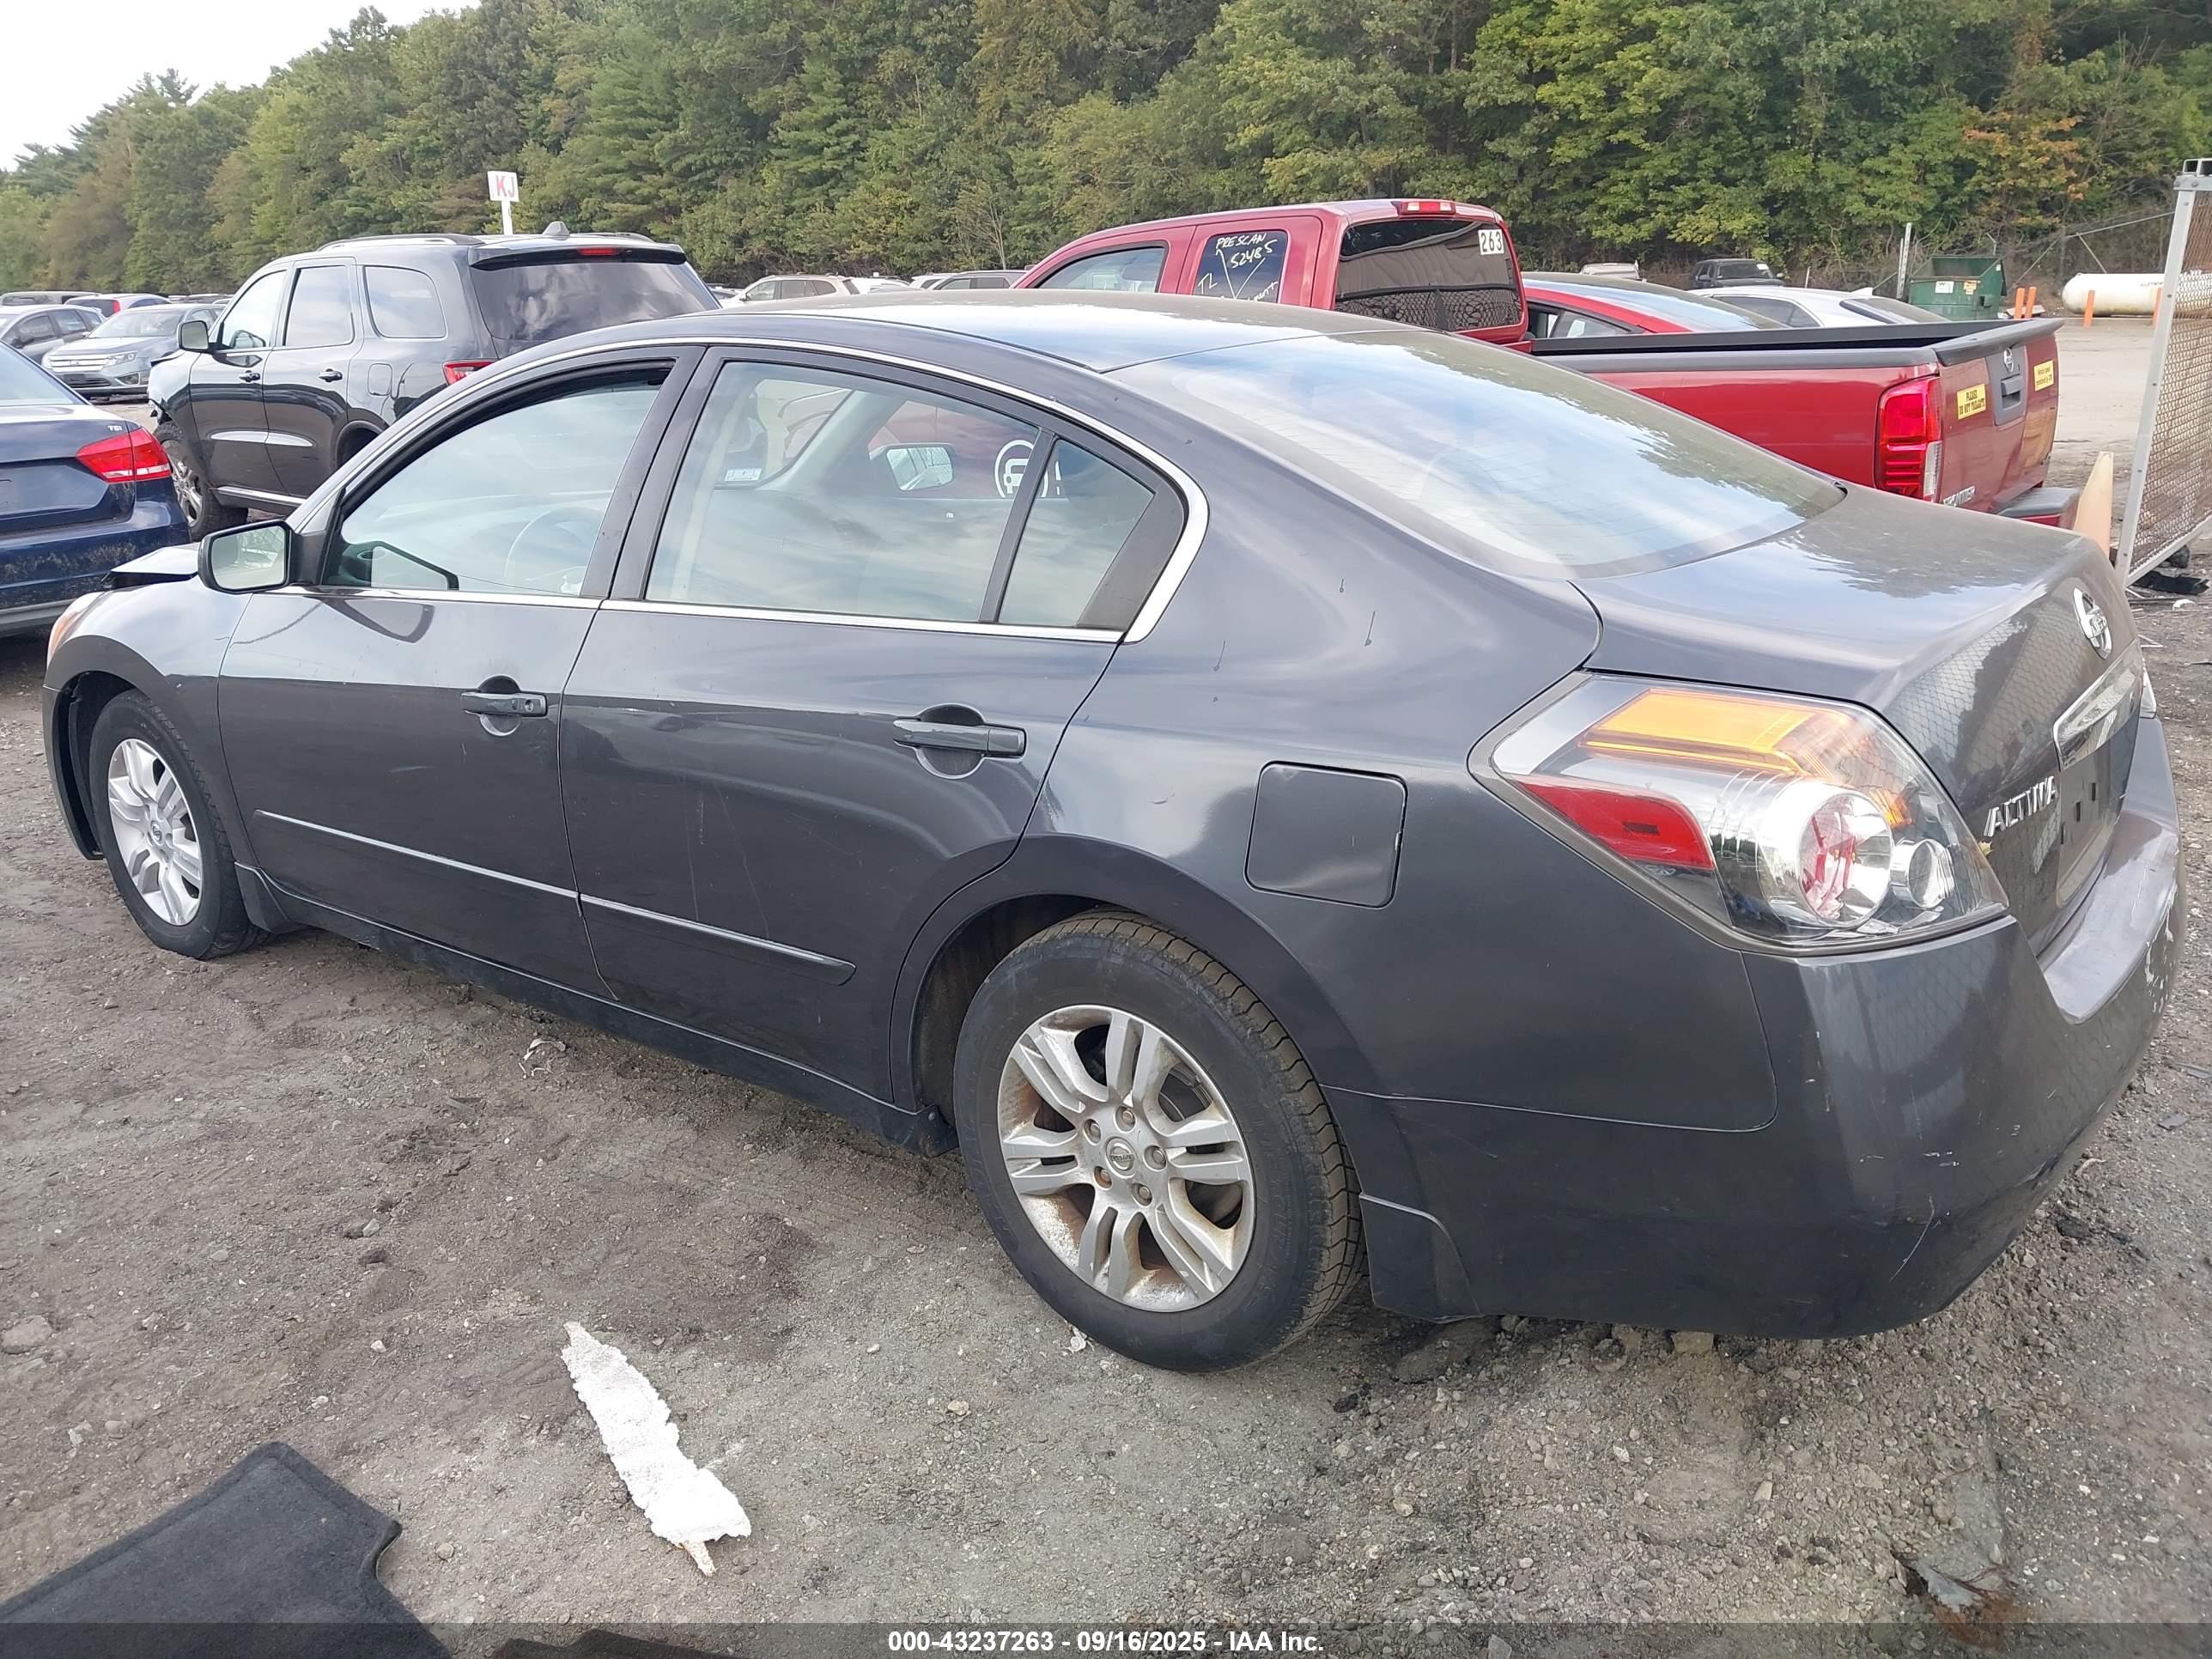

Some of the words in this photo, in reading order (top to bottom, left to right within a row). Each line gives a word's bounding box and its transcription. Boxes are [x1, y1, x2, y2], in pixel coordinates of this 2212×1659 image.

[495, 175, 515, 198] KJ
[1216, 232, 1267, 249] PRESCAN
[1481, 231, 1502, 252] 263
[1231, 239, 1278, 268] 52485
[1983, 775, 2058, 837] ALTIMA
